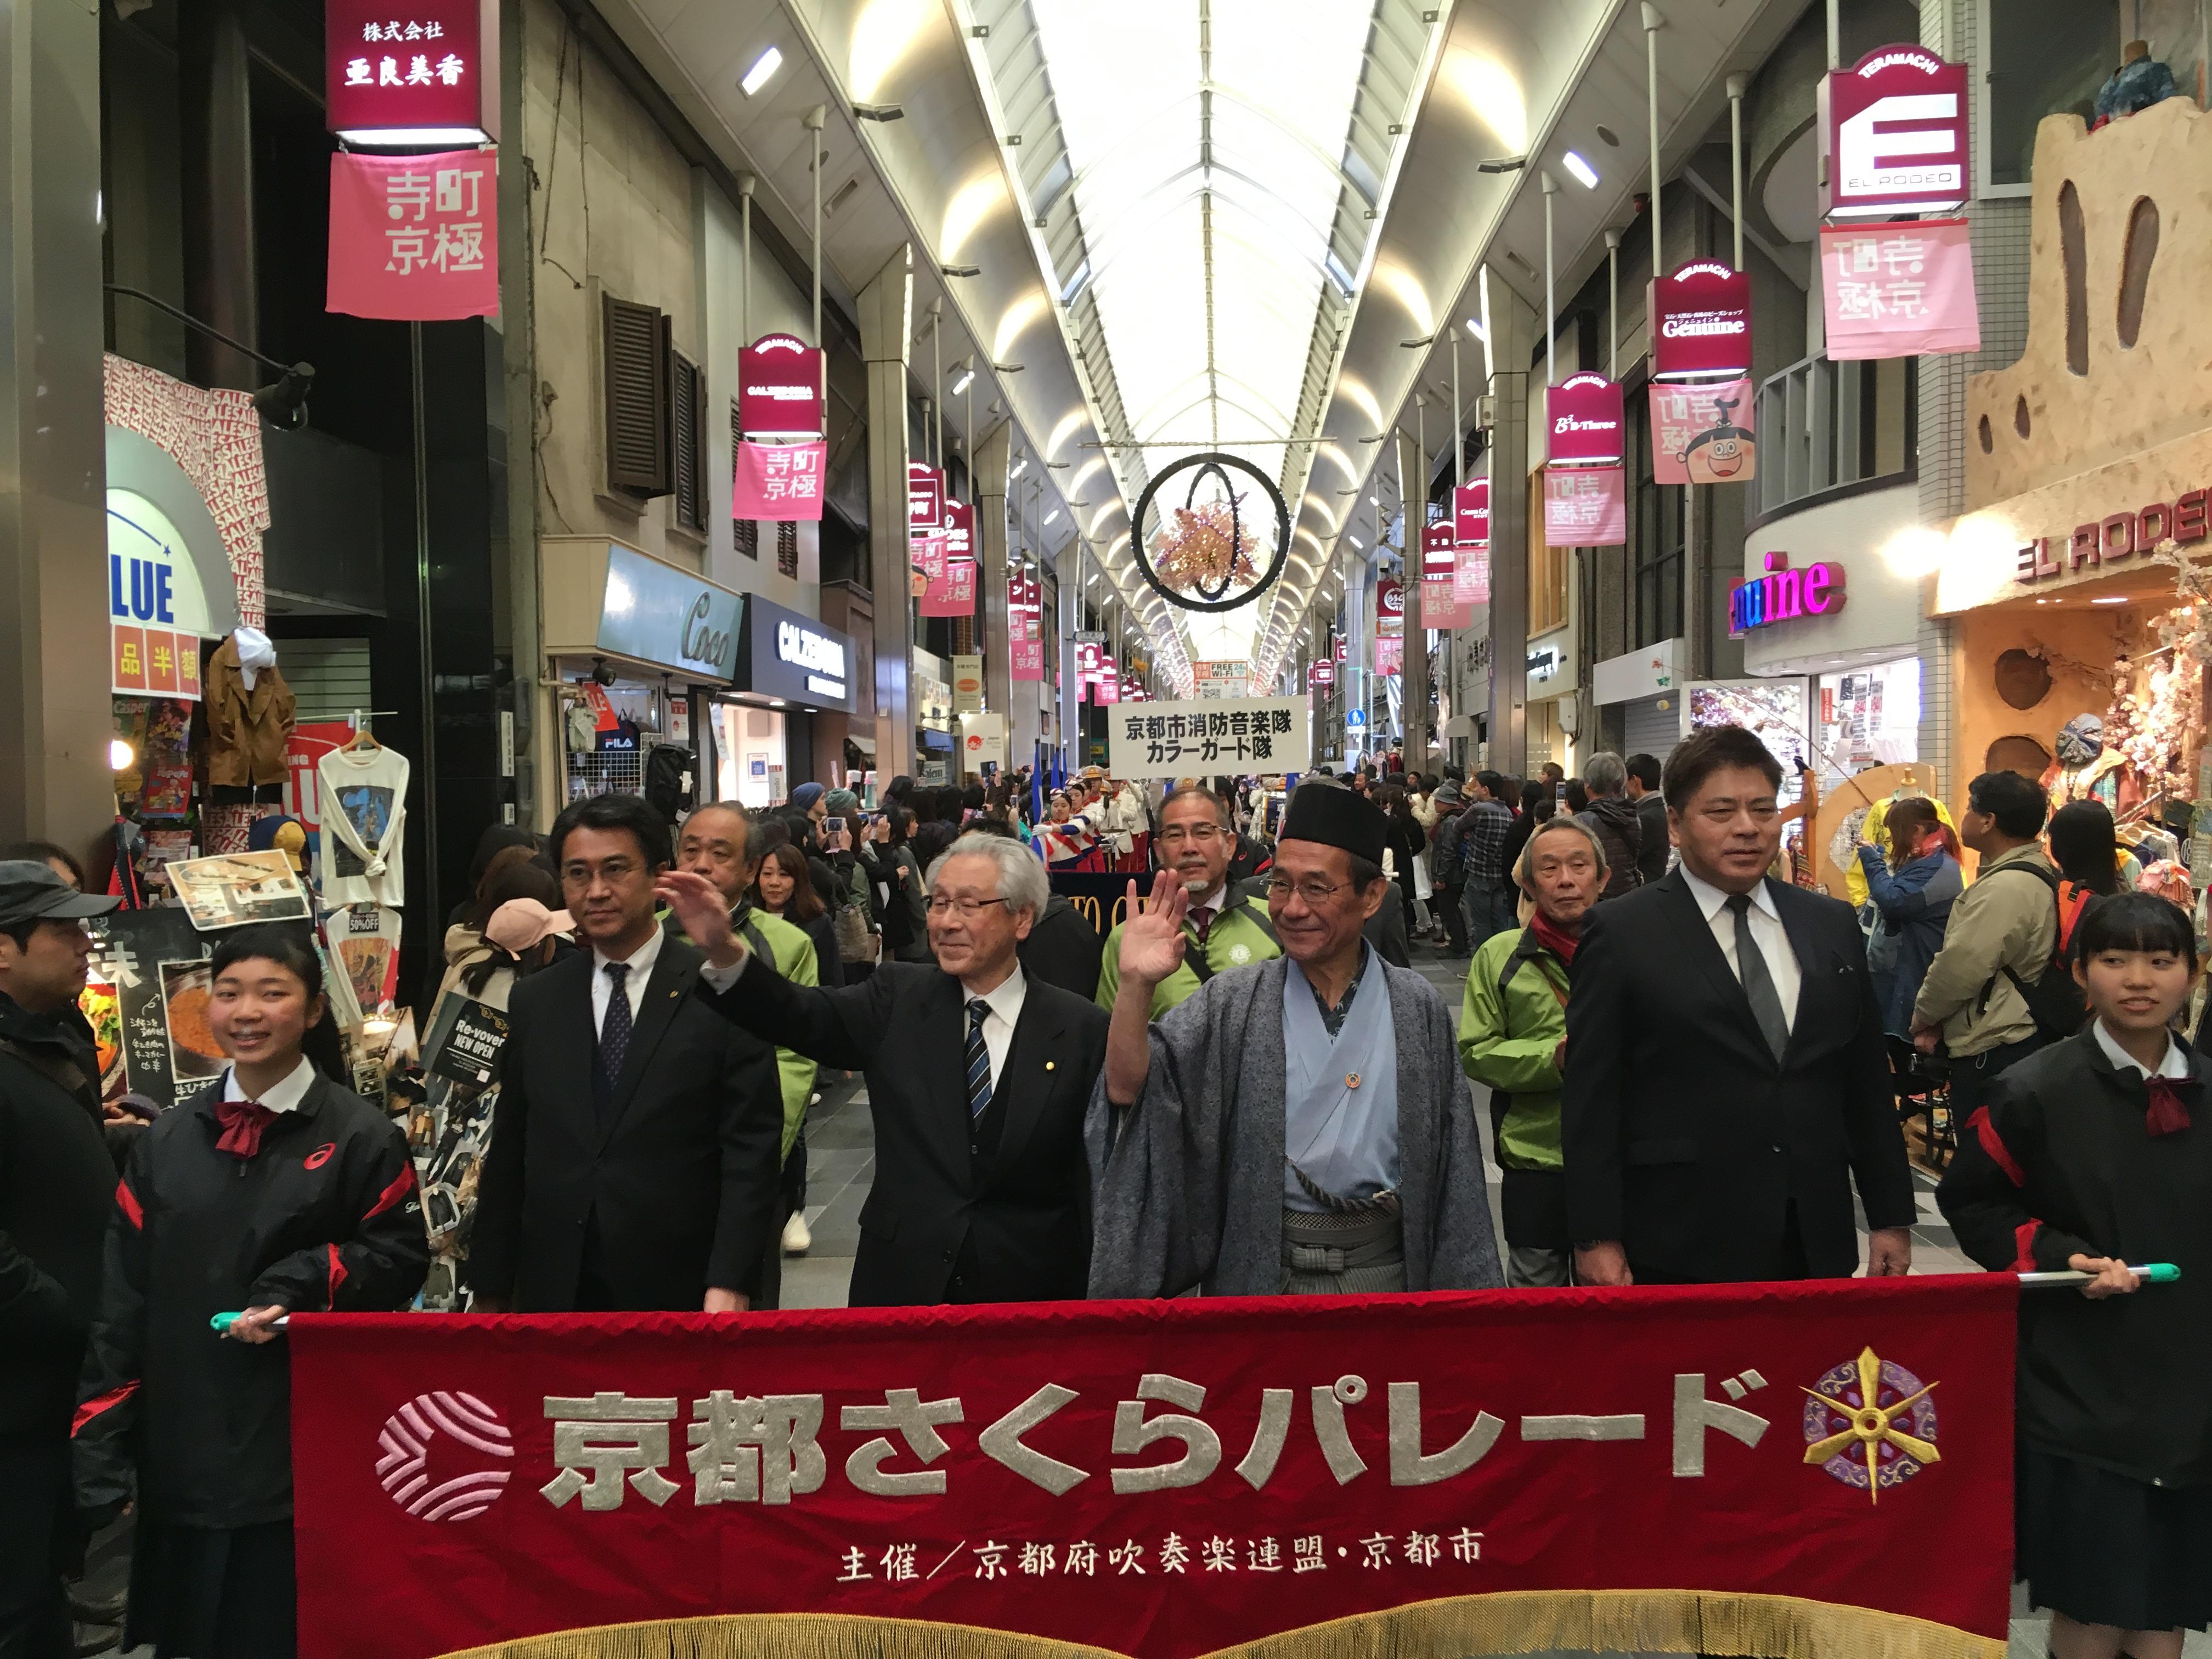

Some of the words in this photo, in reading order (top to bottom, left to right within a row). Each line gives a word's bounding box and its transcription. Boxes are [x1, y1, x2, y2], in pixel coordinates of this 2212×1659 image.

[362, 20, 444, 42] 株式会社
[344, 53, 464, 87] 亜良美香
[1858, 53, 1939, 78] TERAMACHI
[1848, 178, 1872, 188] EL
[1879, 173, 1953, 185] RODEO
[386, 168, 484, 222] 寺町
[385, 223, 484, 275] 京極
[1674, 264, 1731, 282] TERAMACHI
[1662, 317, 1745, 338] Genuine
[755, 338, 804, 354] TERAMACHI
[1562, 376, 1607, 390] TERAMACHI
[1570, 420, 1617, 431] B-Three
[766, 449, 820, 476] 寺町
[762, 475, 817, 501] 京極
[2015, 537, 2061, 582] EL
[2068, 486, 2212, 569] RODE
[681, 591, 730, 667] Coco
[1125, 709, 1292, 741] 京都市消防音楽隊
[605, 738, 633, 748] FILA
[1147, 735, 1273, 764] カラーガード隊
[349, 918, 379, 931] 50%OFF
[453, 1033, 475, 1051] NEW
[472, 1041, 495, 1059] OPEN
[455, 1019, 506, 1048] Re-vover
[539, 1368, 1771, 1512] 京都さくらパレード
[835, 1527, 1485, 1583] 主催／京都府吹奏楽連盟・京都市
